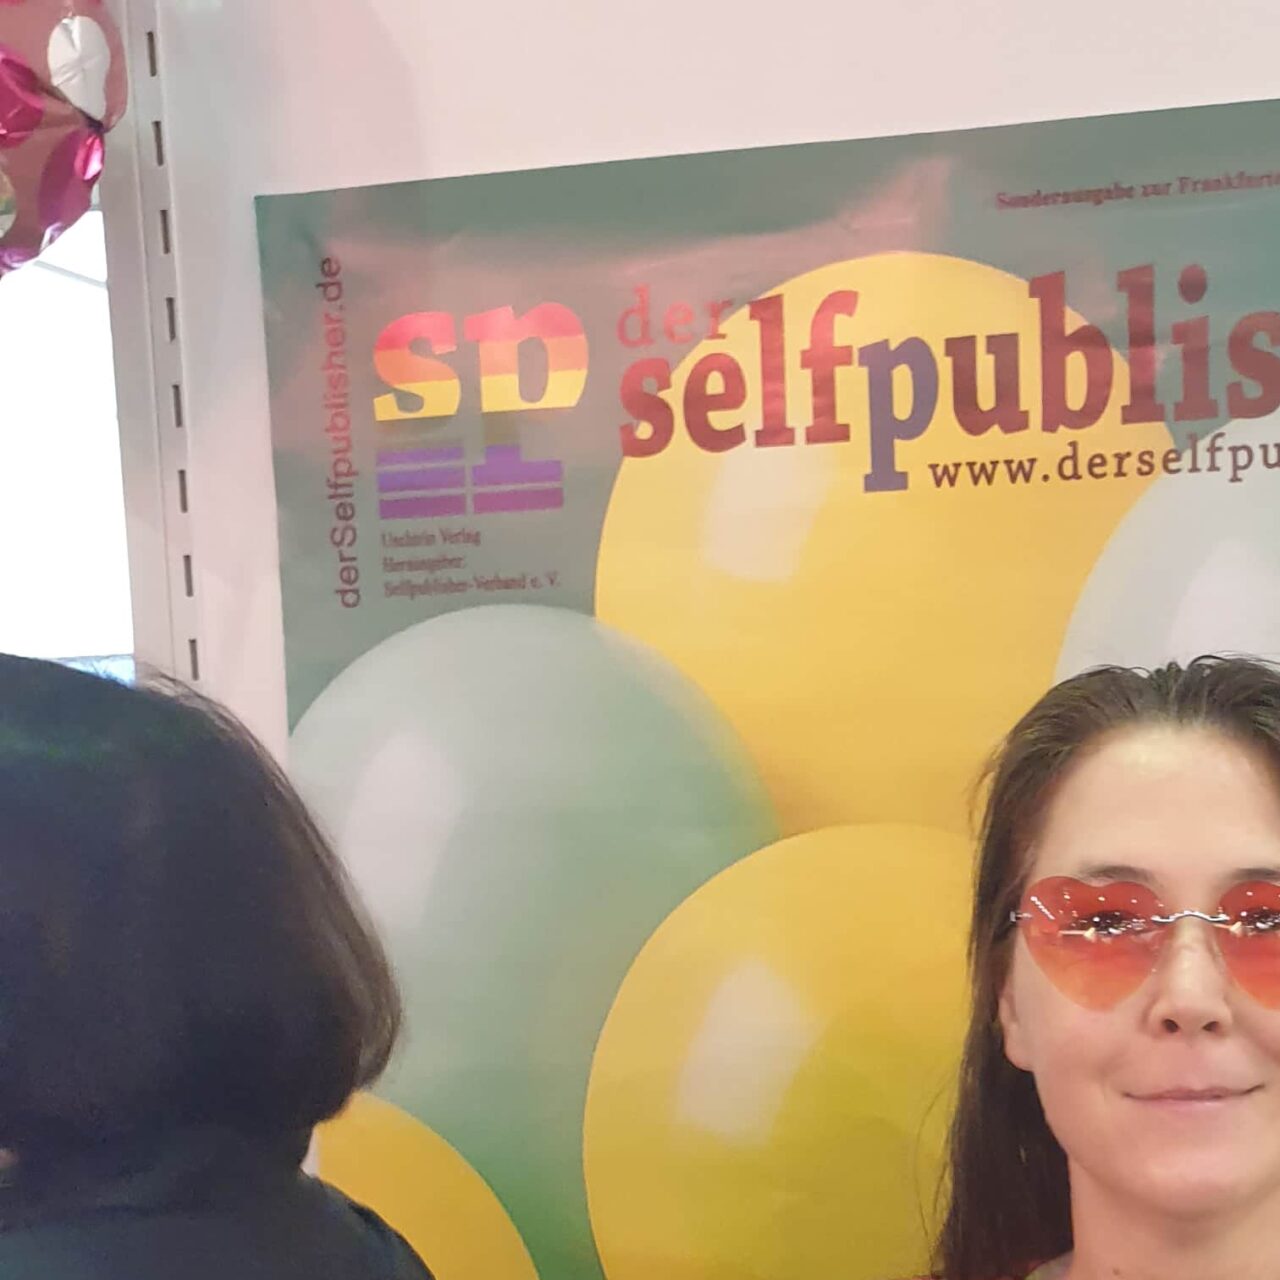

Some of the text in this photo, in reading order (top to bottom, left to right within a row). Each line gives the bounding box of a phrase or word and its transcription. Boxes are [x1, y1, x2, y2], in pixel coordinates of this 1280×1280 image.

[996, 183, 1134, 210] Sonderausgabe
[1142, 183, 1172, 197] zur
[616, 283, 735, 348] der
[315, 256, 360, 608] derSelfpublisher.de
